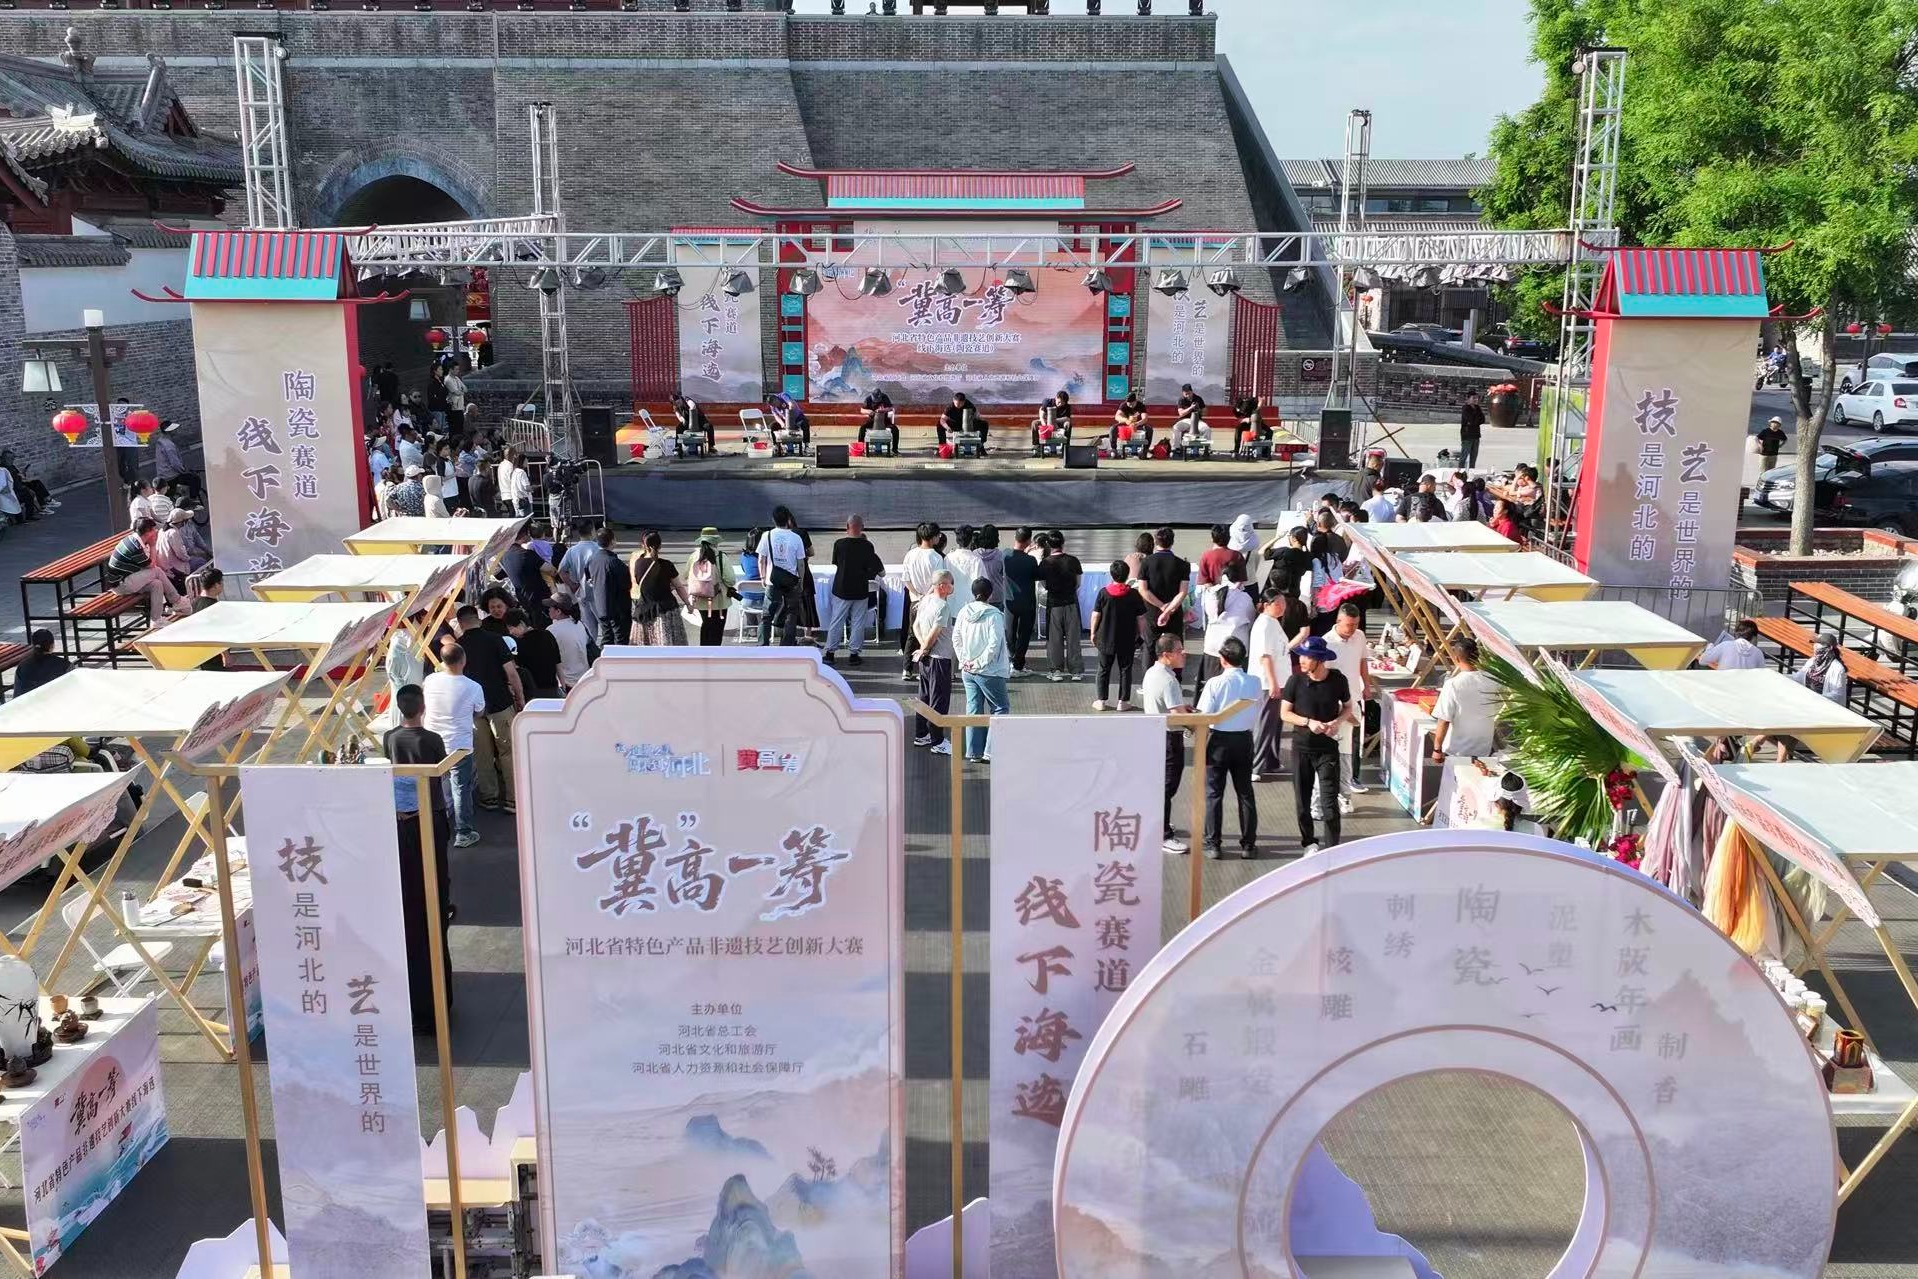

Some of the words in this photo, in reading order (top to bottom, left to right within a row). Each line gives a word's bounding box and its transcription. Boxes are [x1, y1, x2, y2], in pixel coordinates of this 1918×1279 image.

[700, 294, 723, 383] 线下海选
[896, 279, 1015, 328] “冀高一筹
[1191, 299, 1208, 376] 艺是世界的
[283, 369, 320, 499] 陶瓷赛道
[1630, 389, 1679, 560] 技是河北的
[1669, 442, 1713, 600] 艺是世界的
[277, 836, 328, 1015] 技是河北的
[1094, 806, 1142, 993] 陶瓷赛道
[1384, 894, 1415, 959] 刺绣
[1454, 883, 1500, 986] 陶瓷
[1549, 904, 1578, 969] 泥塑
[565, 936, 864, 956] 河北省特色产品非遗技艺创新大赛
[1321, 946, 1354, 1021] 核雕
[1609, 906, 1655, 1052] 木版年画
[678, 1024, 757, 1038] 河北省总工会
[691, 1003, 743, 1016] 主办单位
[1011, 875, 1083, 1129] 线下海选
[346, 974, 386, 1133] 艺是世界的
[632, 1062, 805, 1075] 河北省人力资源和社会保障厅
[658, 1043, 778, 1057] 河北省文化和旅游厅
[1179, 1031, 1211, 1101] 石雕
[1652, 1032, 1688, 1106] 制香
